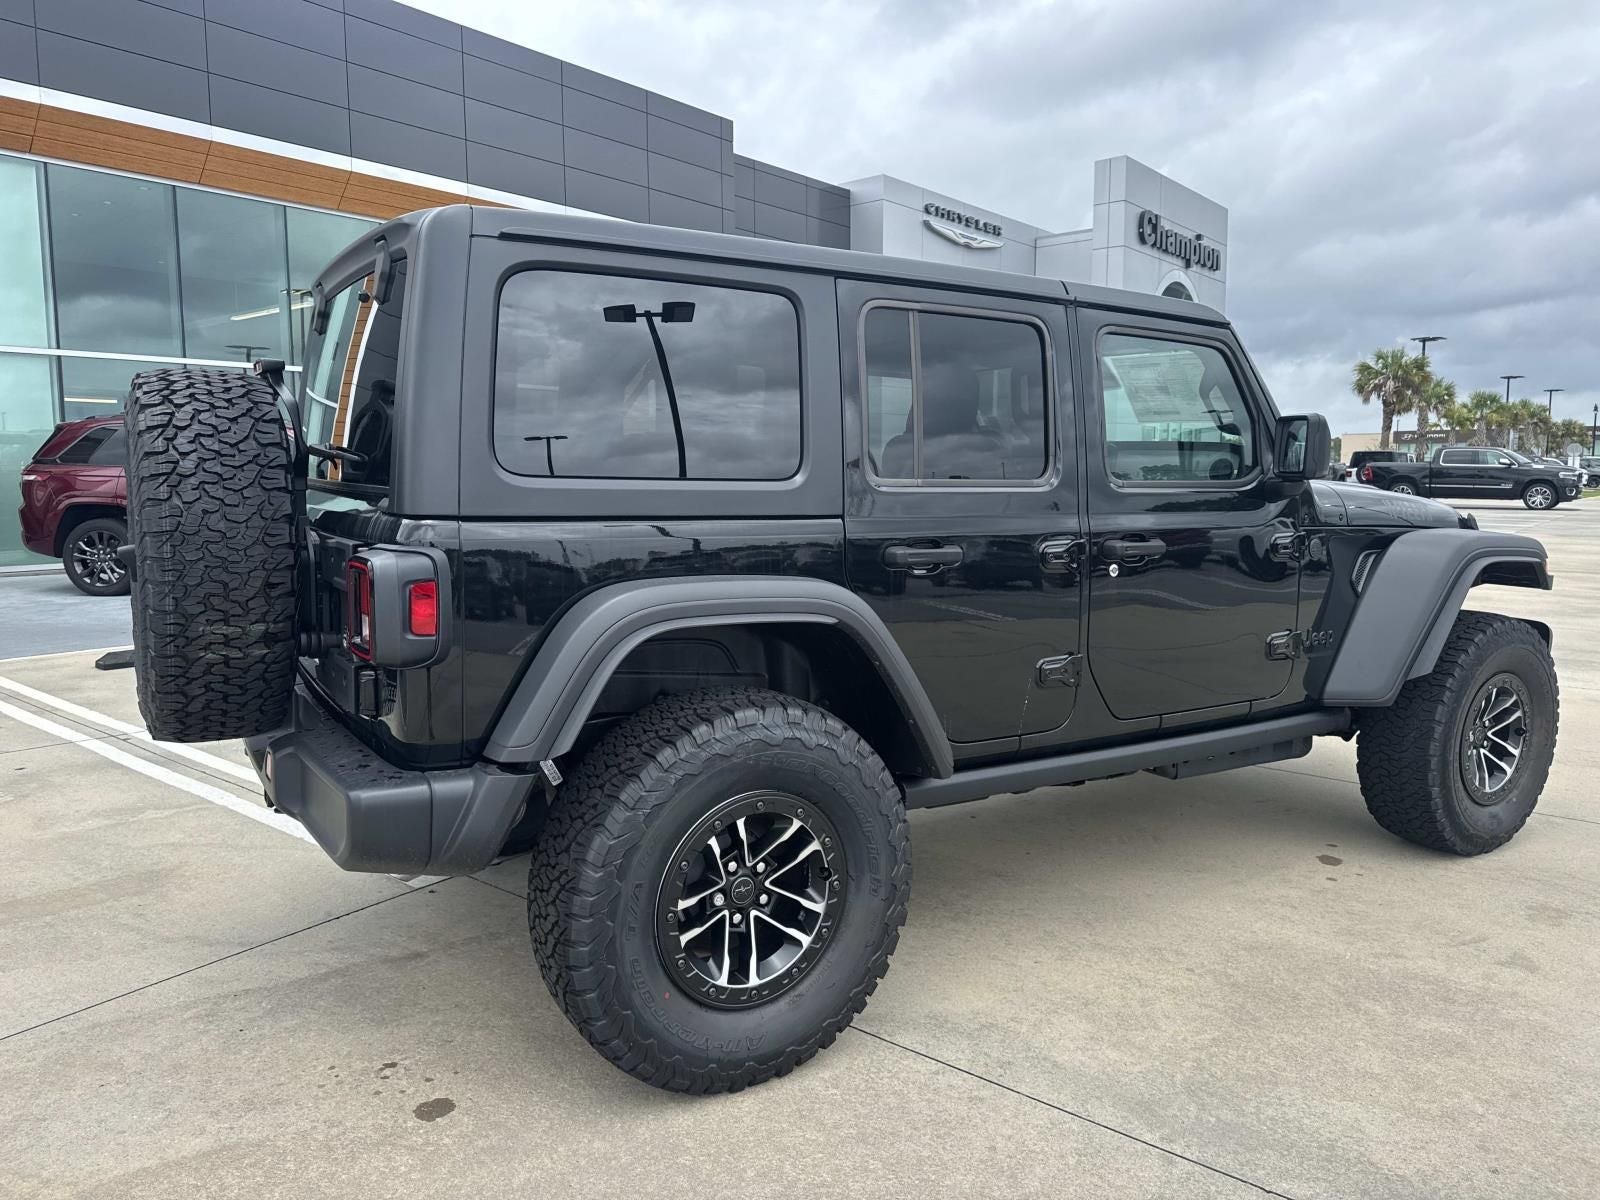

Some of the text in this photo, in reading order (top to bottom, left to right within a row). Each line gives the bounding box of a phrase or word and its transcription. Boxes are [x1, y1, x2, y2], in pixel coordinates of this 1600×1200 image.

[923, 202, 1003, 237] CHRYSLER
[1138, 210, 1222, 272] Champion
[1305, 628, 1334, 648] Jeep
